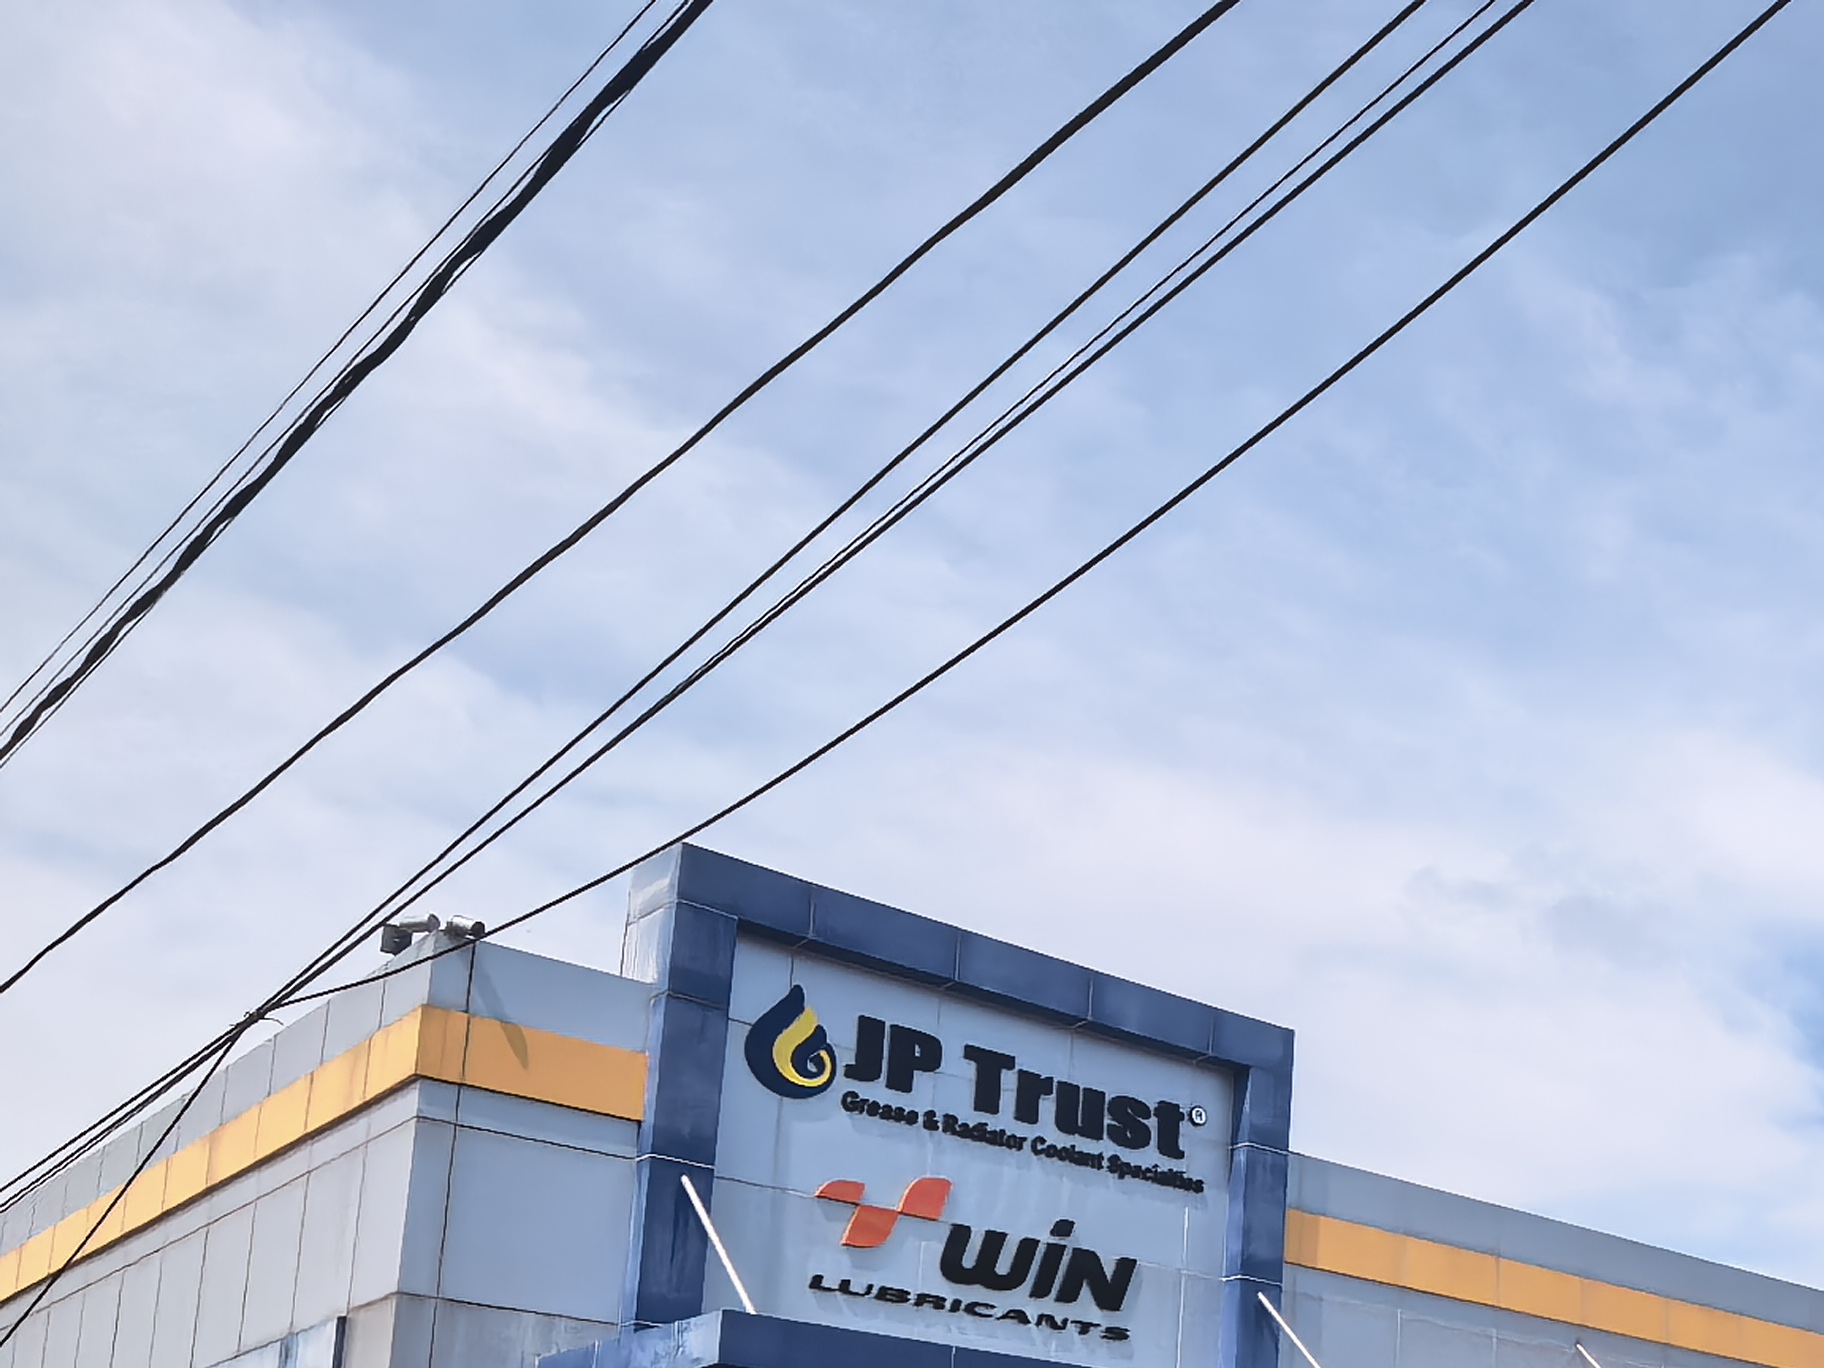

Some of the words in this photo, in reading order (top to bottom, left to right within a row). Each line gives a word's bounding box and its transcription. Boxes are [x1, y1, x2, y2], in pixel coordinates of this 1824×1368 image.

[843, 1015, 943, 1094] JP
[963, 1044, 1186, 1160] Trust
[841, 1091, 919, 1125] Grease
[923, 1110, 939, 1131] &
[942, 1113, 1027, 1151] Radiator
[1031, 1136, 1104, 1170] Coolant
[808, 1273, 1131, 1342] LUBRICANTS
